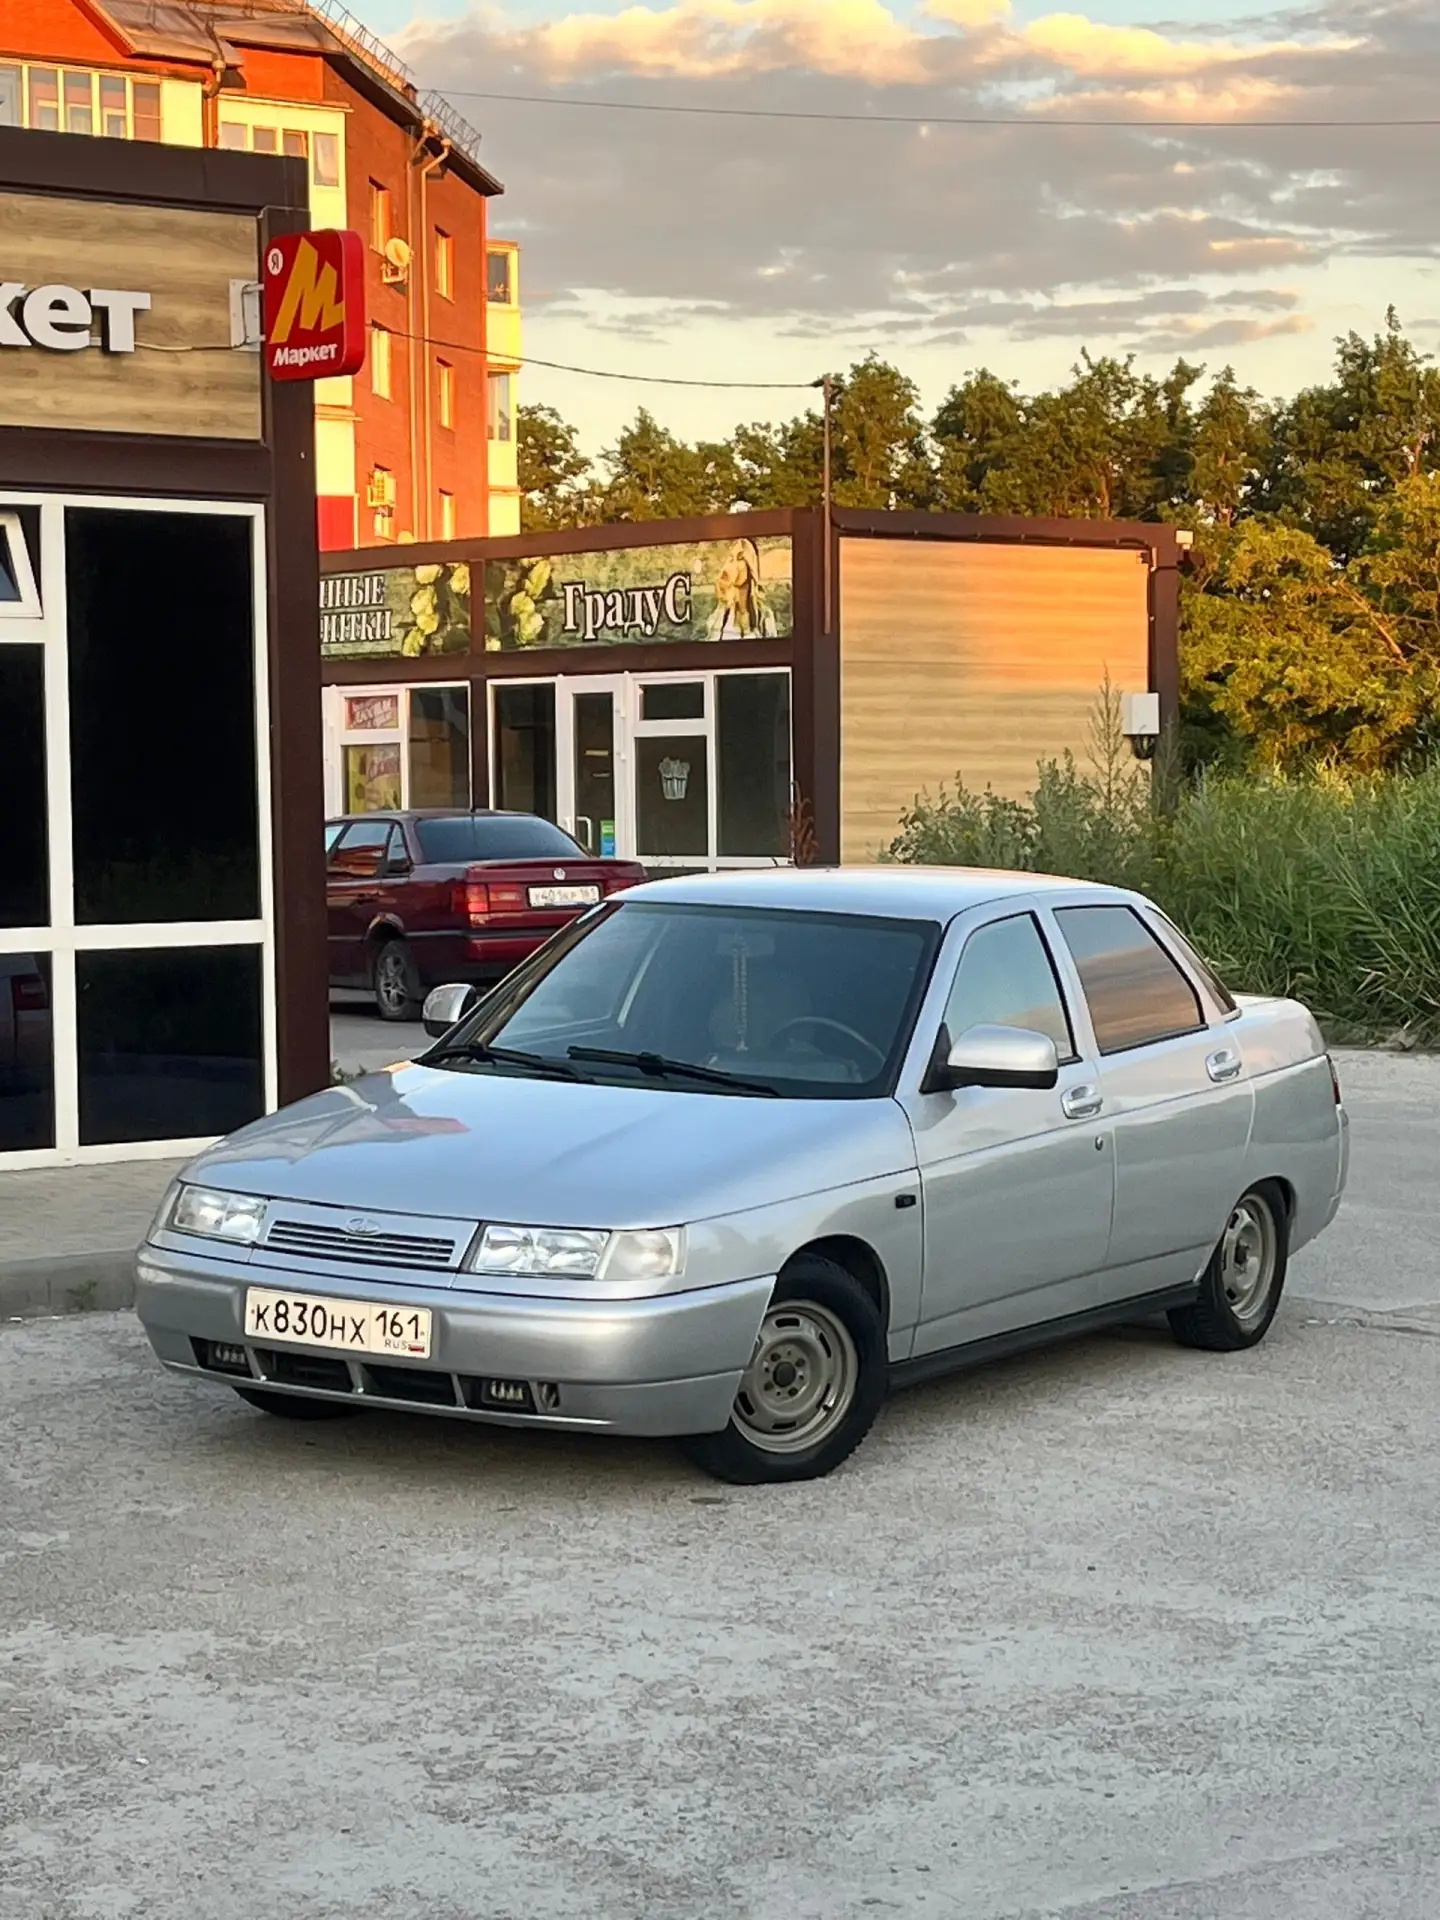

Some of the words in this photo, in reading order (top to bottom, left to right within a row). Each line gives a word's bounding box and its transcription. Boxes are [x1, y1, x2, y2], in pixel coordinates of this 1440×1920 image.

[272, 343, 338, 367] Маркет
[255, 1299, 365, 1345] К830НХ
[375, 1310, 420, 1340] 161
[384, 1339, 408, 1351] RUS
